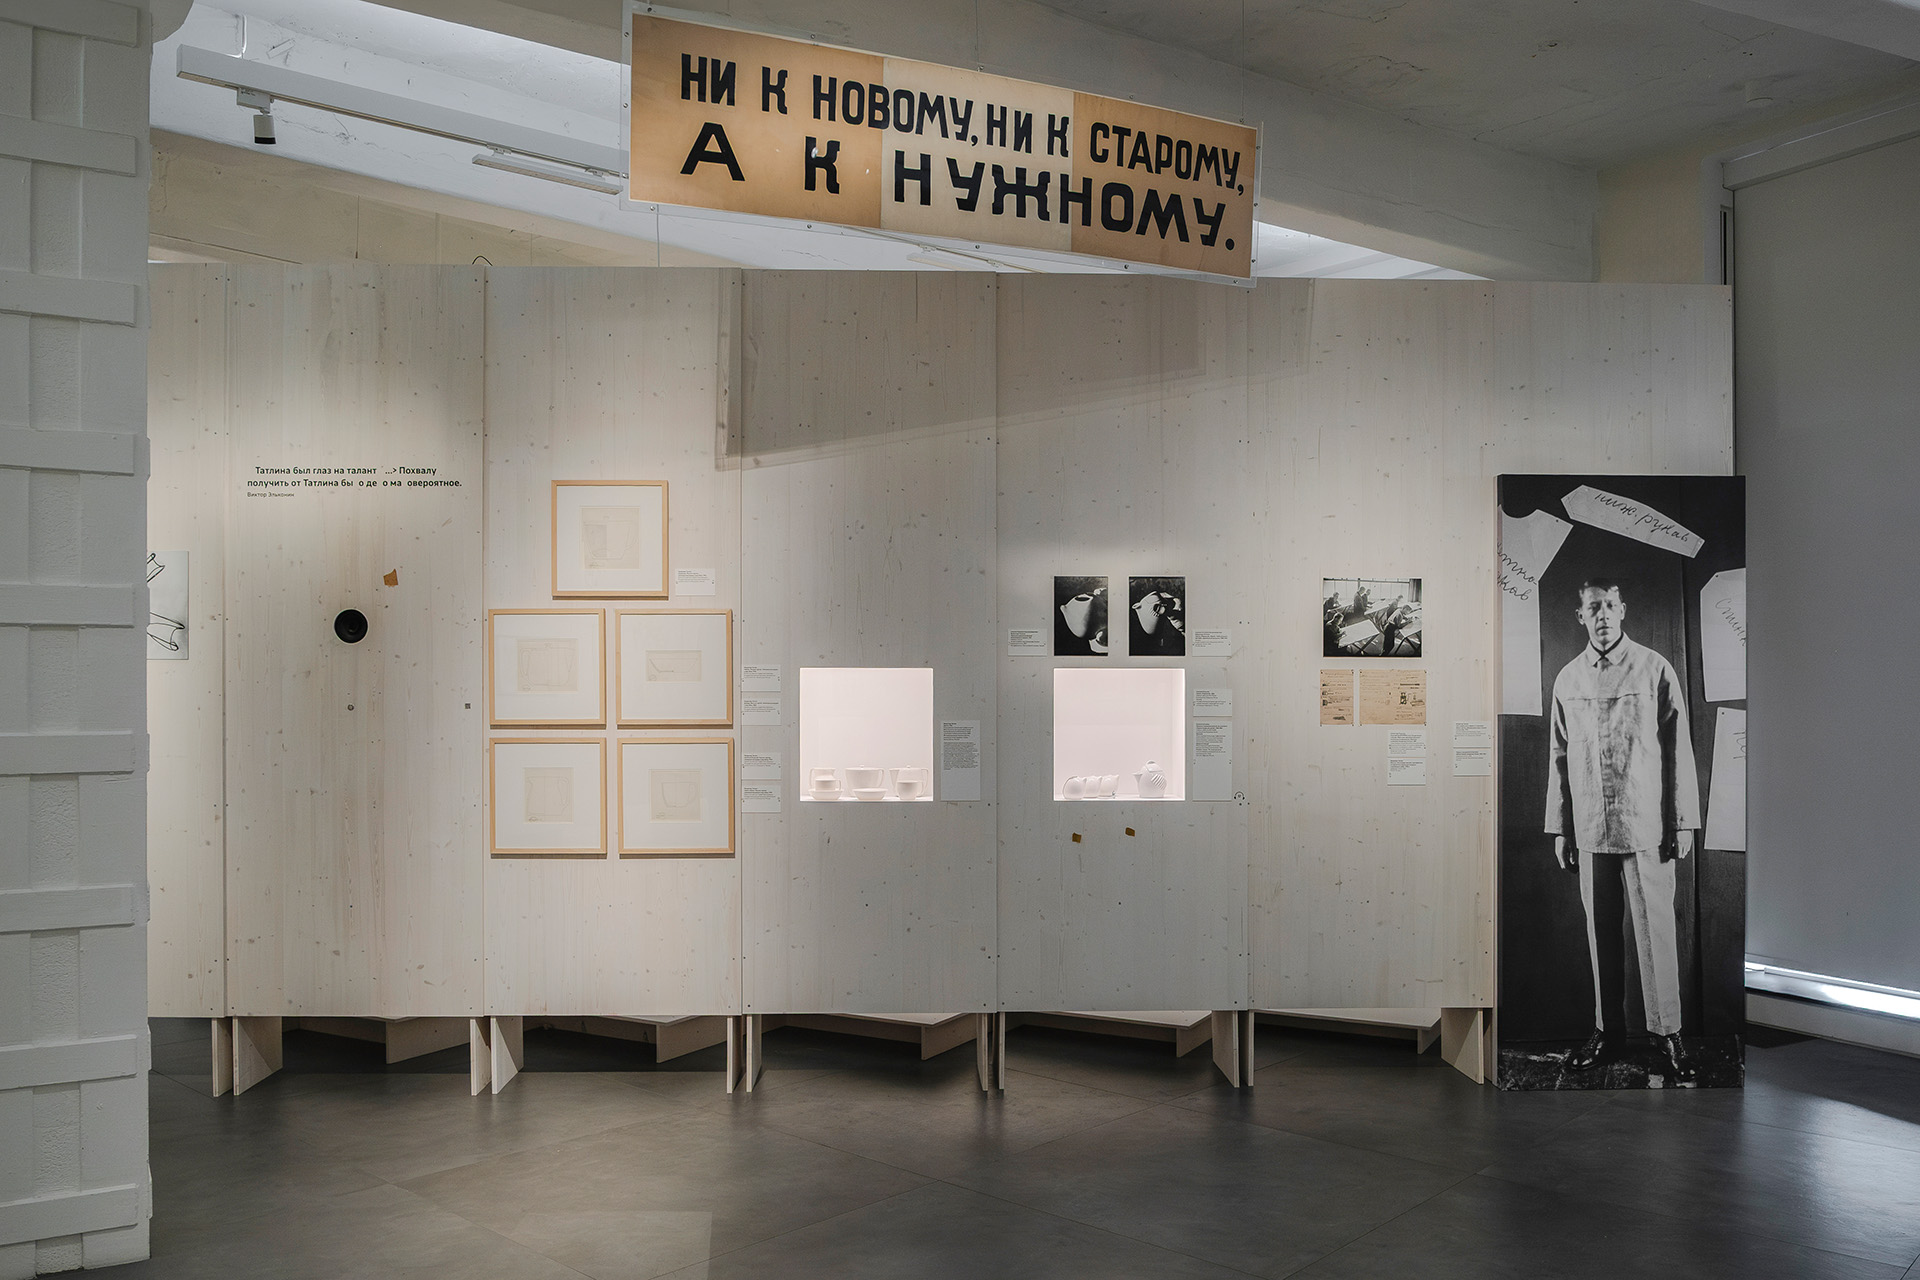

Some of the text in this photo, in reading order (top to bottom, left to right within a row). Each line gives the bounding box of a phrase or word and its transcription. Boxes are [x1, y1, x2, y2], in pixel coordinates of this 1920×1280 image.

[681, 53, 1245, 196] НИ К НОВОМУ, НИ К СТАРОМУ,
[679, 122, 1235, 251] А К НУЖНОМУ.
[247, 480, 289, 489] получить
[303, 478, 339, 487] Татлина
[255, 466, 291, 475] Татлина
[292, 466, 311, 475] был
[312, 467, 332, 475] глаз
[334, 467, 345, 475] на
[346, 467, 377, 475] талант
[399, 466, 437, 477] Похвалу
